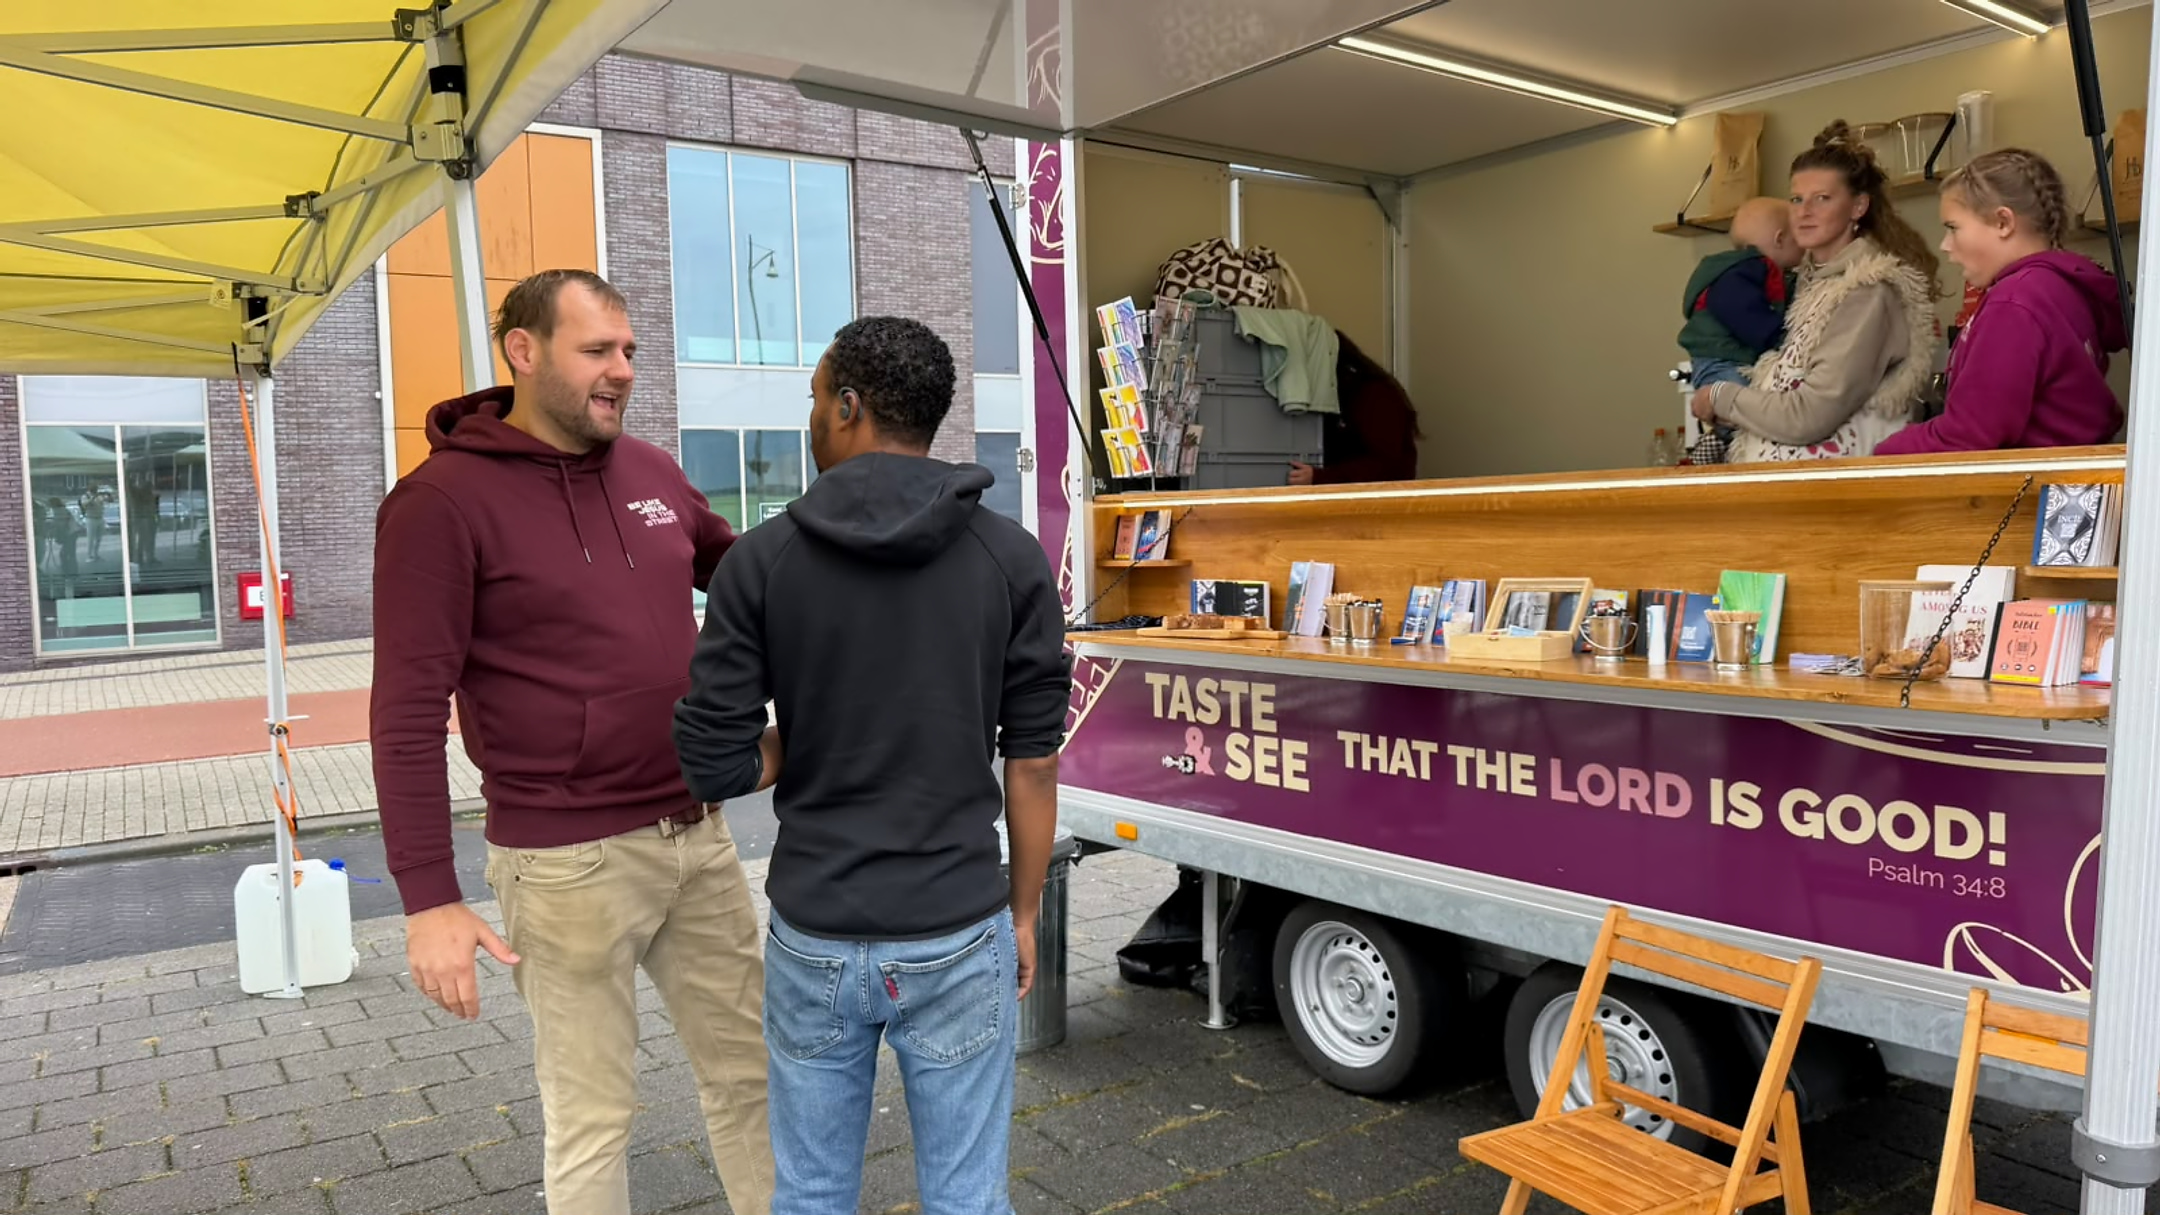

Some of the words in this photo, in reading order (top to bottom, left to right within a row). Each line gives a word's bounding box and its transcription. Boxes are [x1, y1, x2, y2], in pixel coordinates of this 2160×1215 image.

[627, 501, 642, 510] BE
[641, 499, 661, 508] LIKE
[657, 509, 676, 518] THE
[1972, 605, 1988, 614] US
[2012, 620, 2040, 630] BIBLE
[1145, 672, 1278, 733] TASTE
[1185, 726, 1215, 776] &
[1225, 732, 1310, 792] SEE
[1337, 730, 1438, 781] THAT
[1447, 744, 1538, 797] THE
[1550, 757, 1693, 819] LORD
[1709, 778, 1763, 829] IS
[1778, 791, 2006, 866] GOOD!
[1868, 857, 1945, 890] Psalm
[1952, 873, 2006, 899] 34:8
